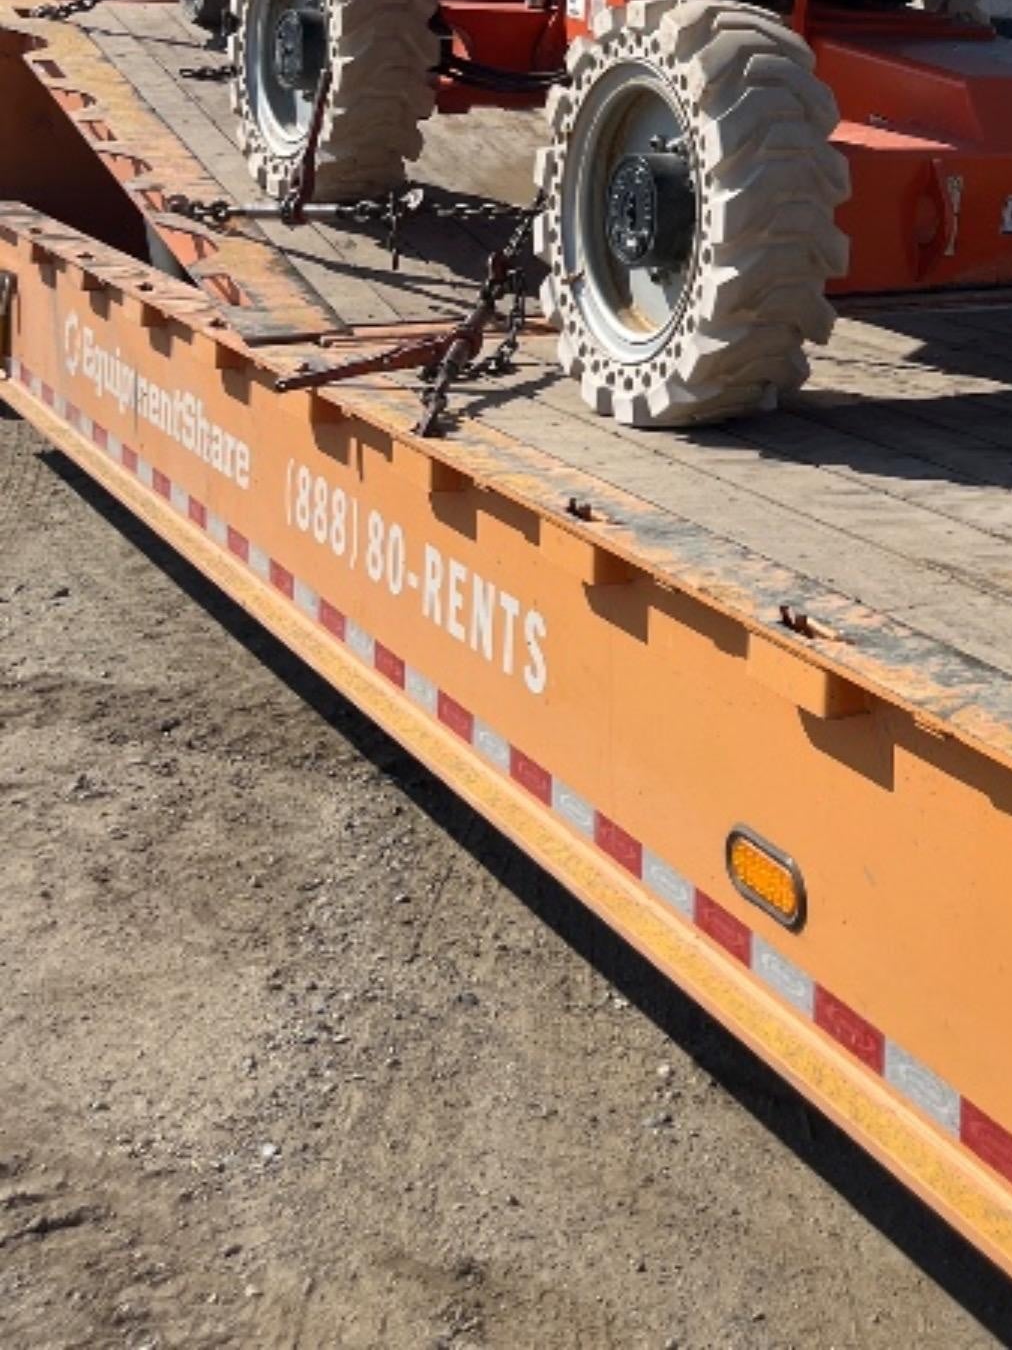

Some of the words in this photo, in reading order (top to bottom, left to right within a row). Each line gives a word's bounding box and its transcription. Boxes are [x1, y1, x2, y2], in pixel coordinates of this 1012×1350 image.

[82, 325, 250, 489] EquipmentShare
[286, 457, 358, 571] (888)
[366, 511, 548, 694] 80-RENTS
